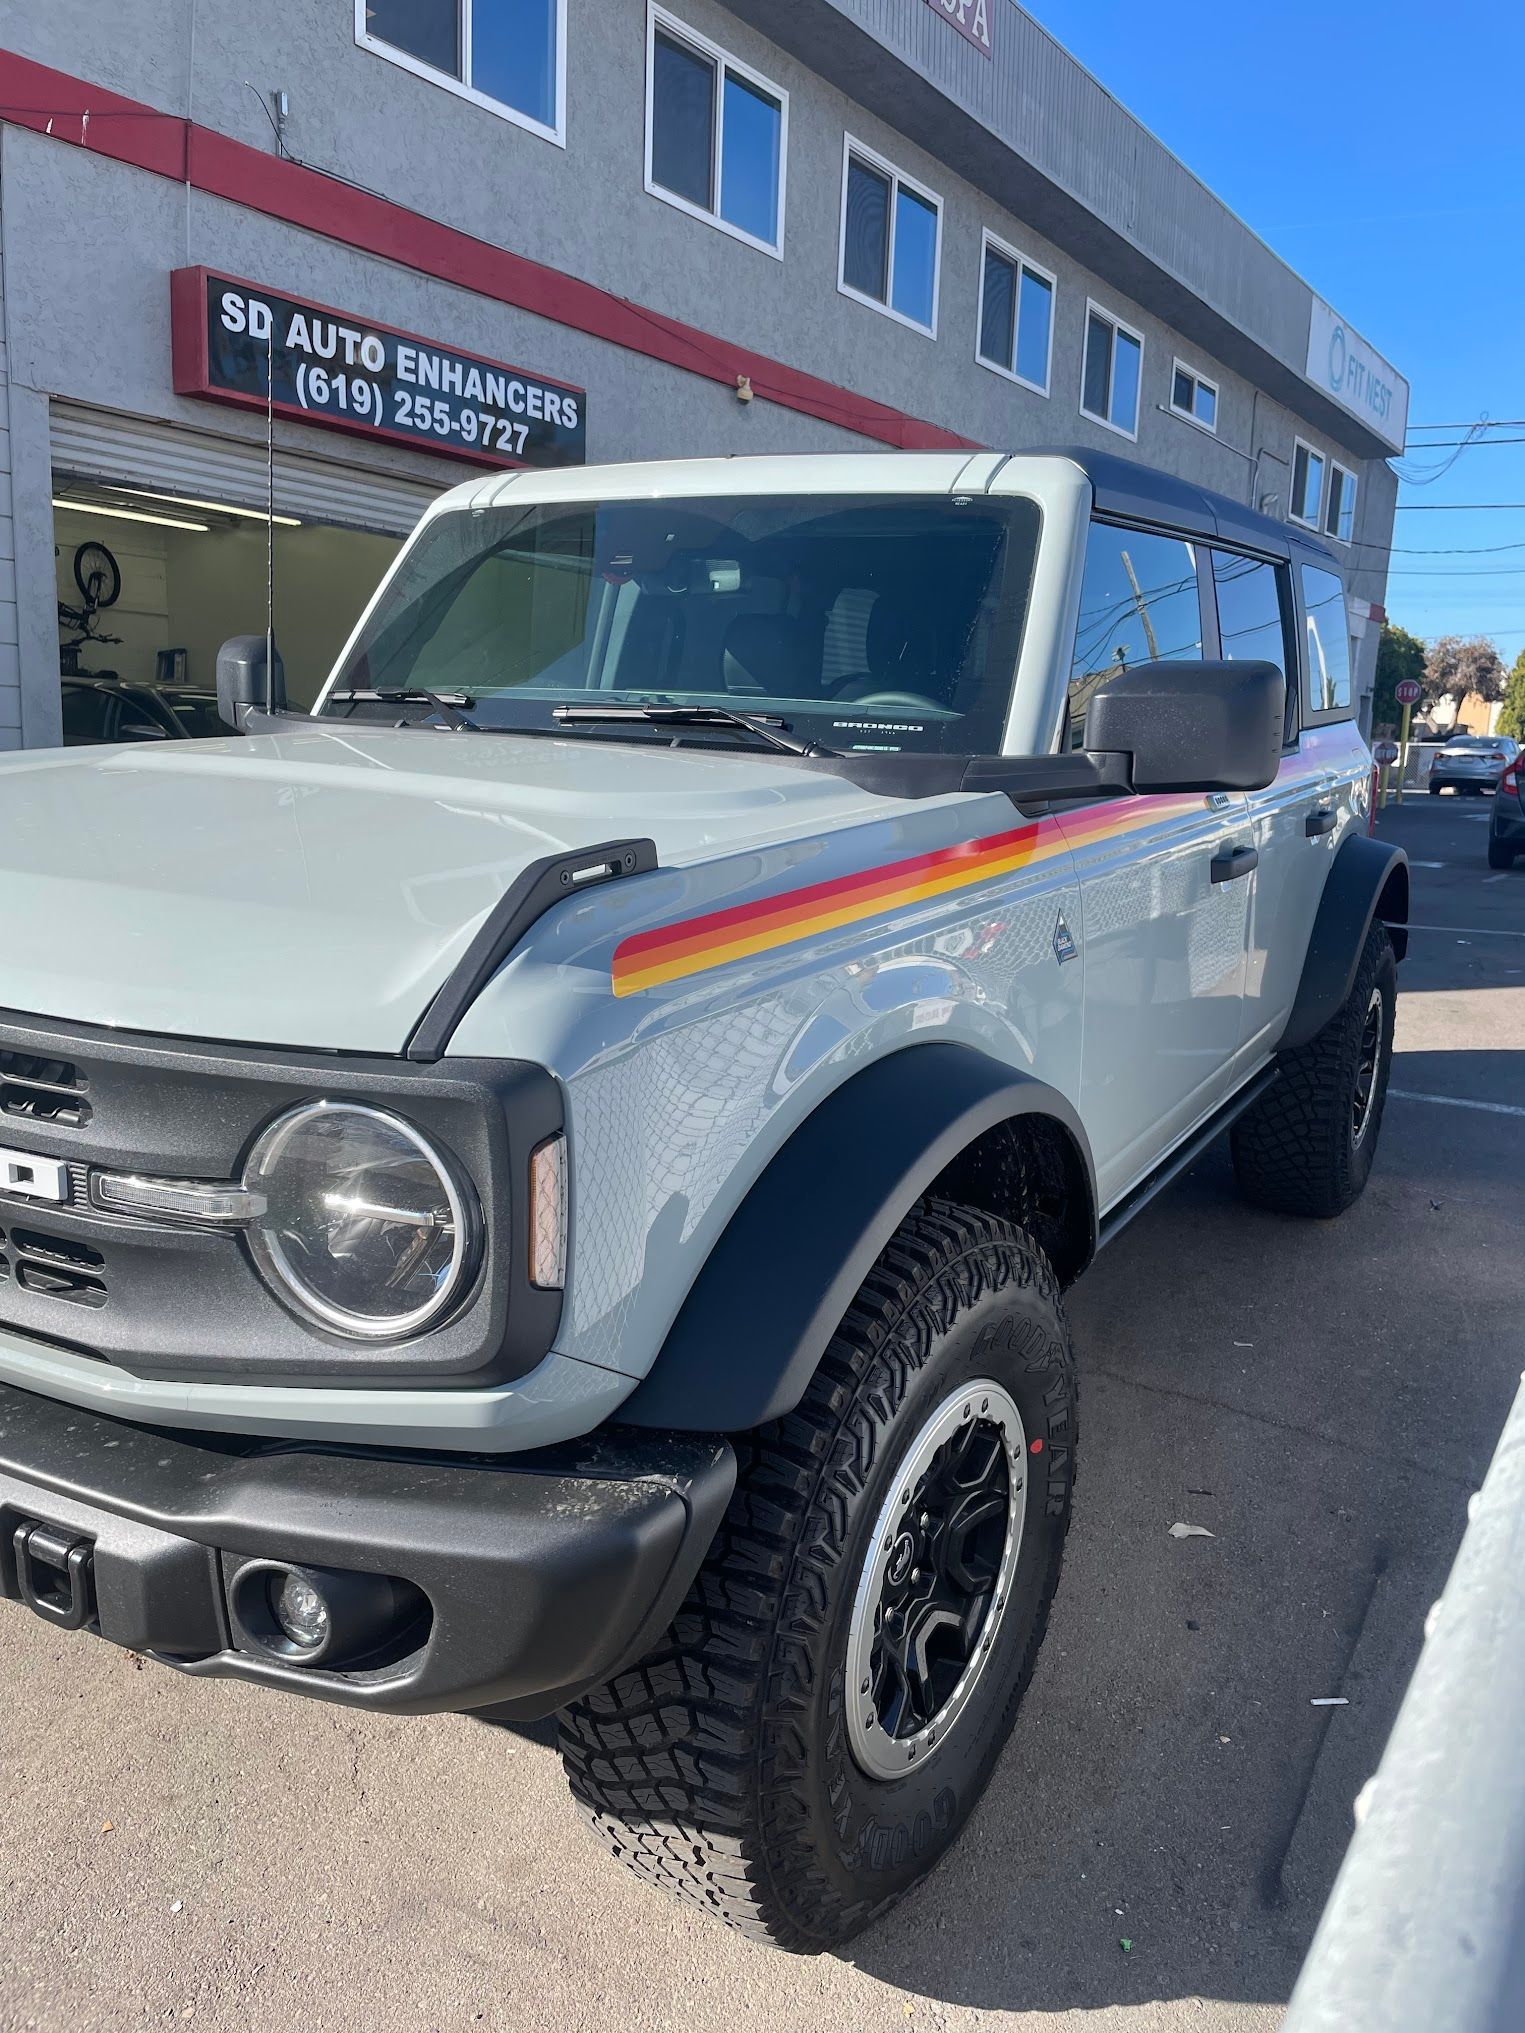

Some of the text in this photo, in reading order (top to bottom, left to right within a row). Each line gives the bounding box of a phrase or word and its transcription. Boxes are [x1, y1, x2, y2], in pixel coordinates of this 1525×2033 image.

[220, 292, 578, 430] SD AUTO ENHANCERS
[1347, 354, 1393, 421] FIT NEST
[296, 363, 530, 455] (619) 255-9727
[1398, 687, 1418, 697] STOP
[833, 721, 924, 732] BRONCO
